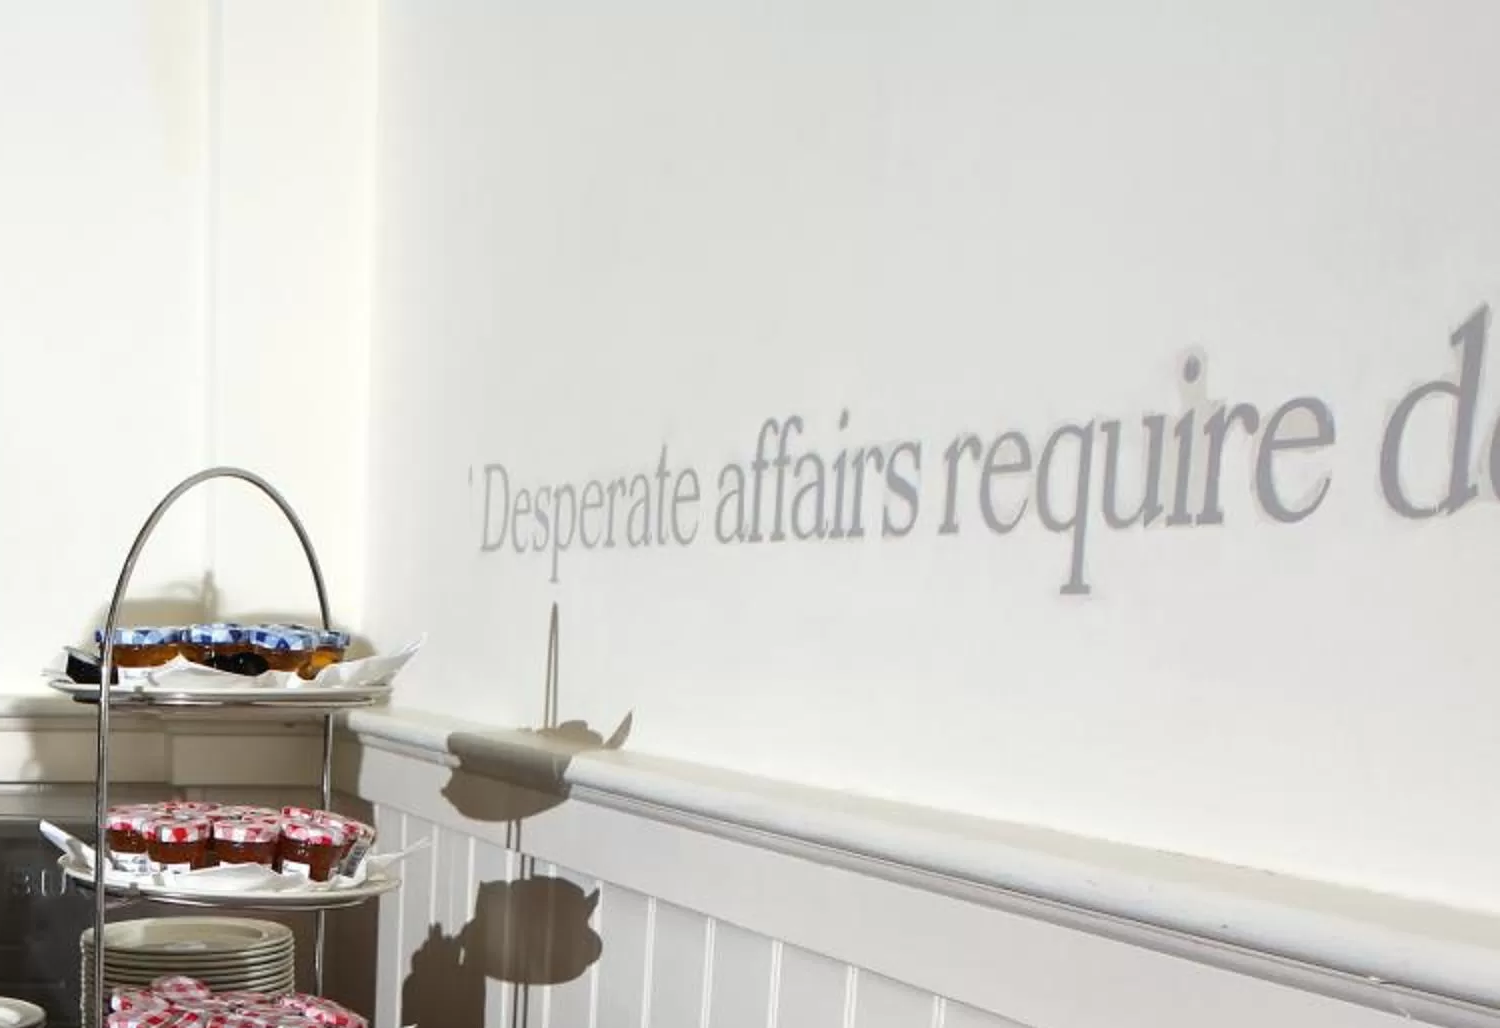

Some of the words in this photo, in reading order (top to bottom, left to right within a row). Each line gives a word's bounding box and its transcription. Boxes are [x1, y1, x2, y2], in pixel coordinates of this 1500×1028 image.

[714, 409, 921, 546] affairs
[937, 355, 1337, 595] require
[1380, 302, 1500, 520] d
